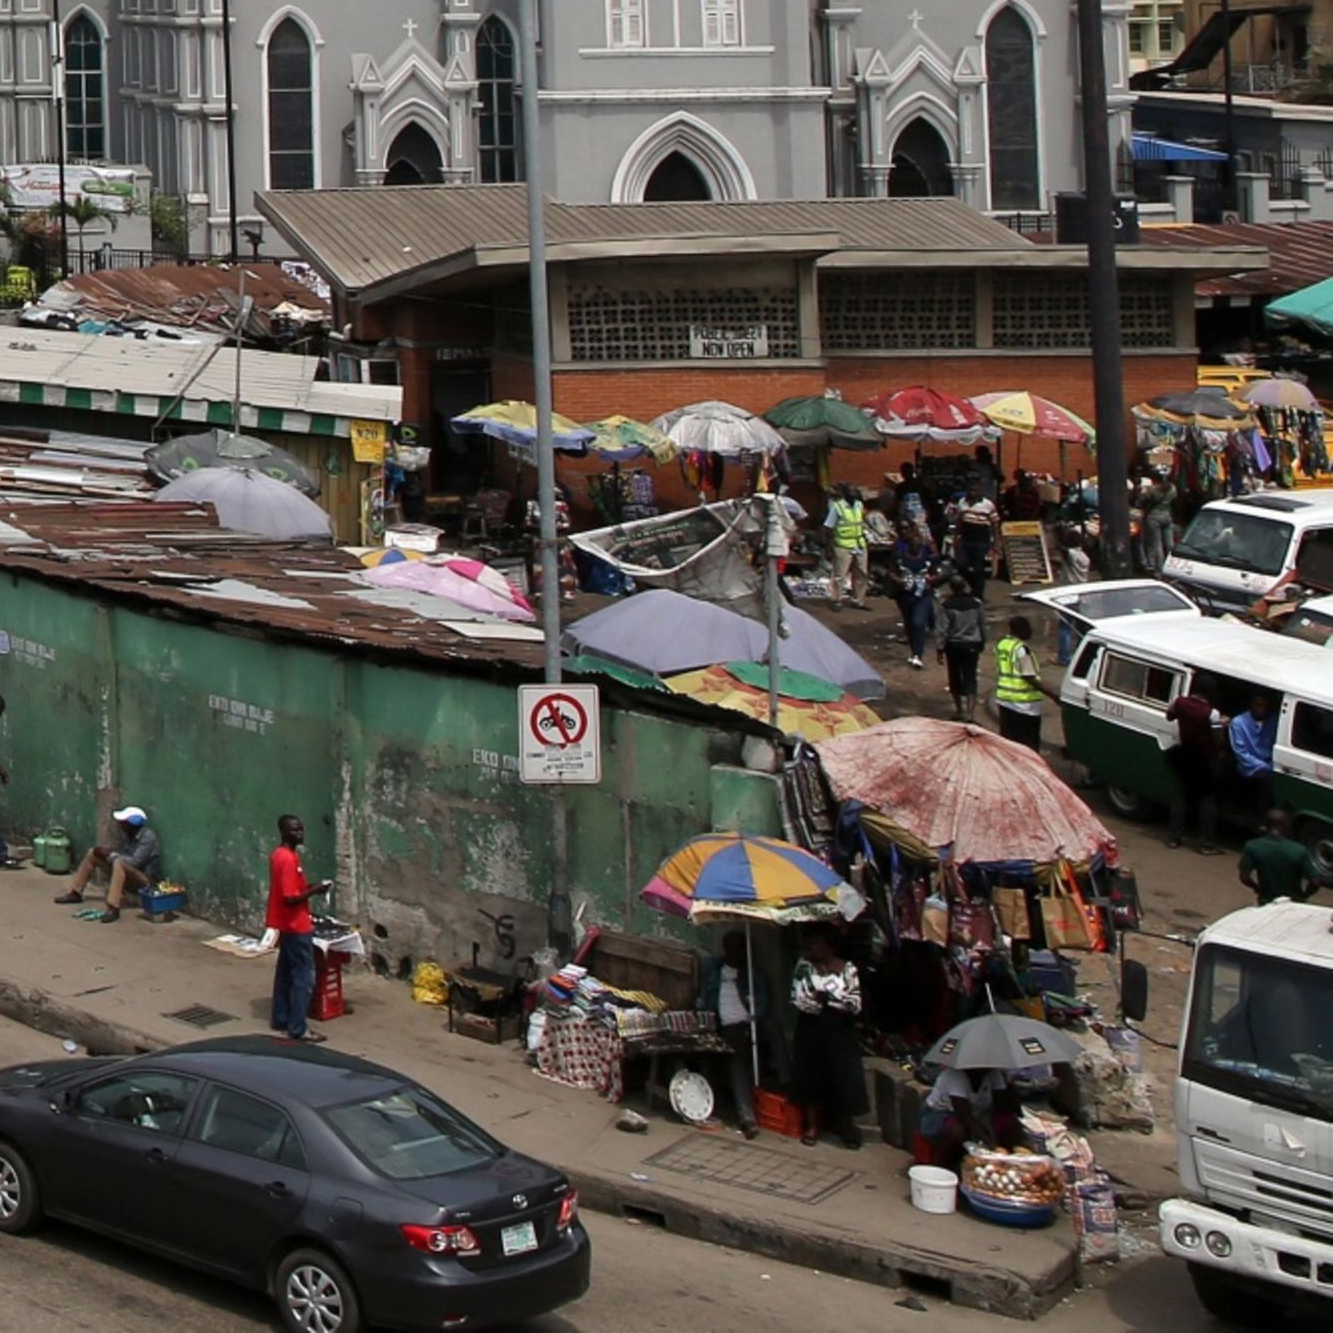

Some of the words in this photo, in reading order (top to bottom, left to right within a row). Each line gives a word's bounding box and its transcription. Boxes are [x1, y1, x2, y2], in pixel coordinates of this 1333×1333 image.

[702, 342, 724, 356] NOW
[727, 342, 754, 357] OPEN
[473, 749, 498, 767] EKO
